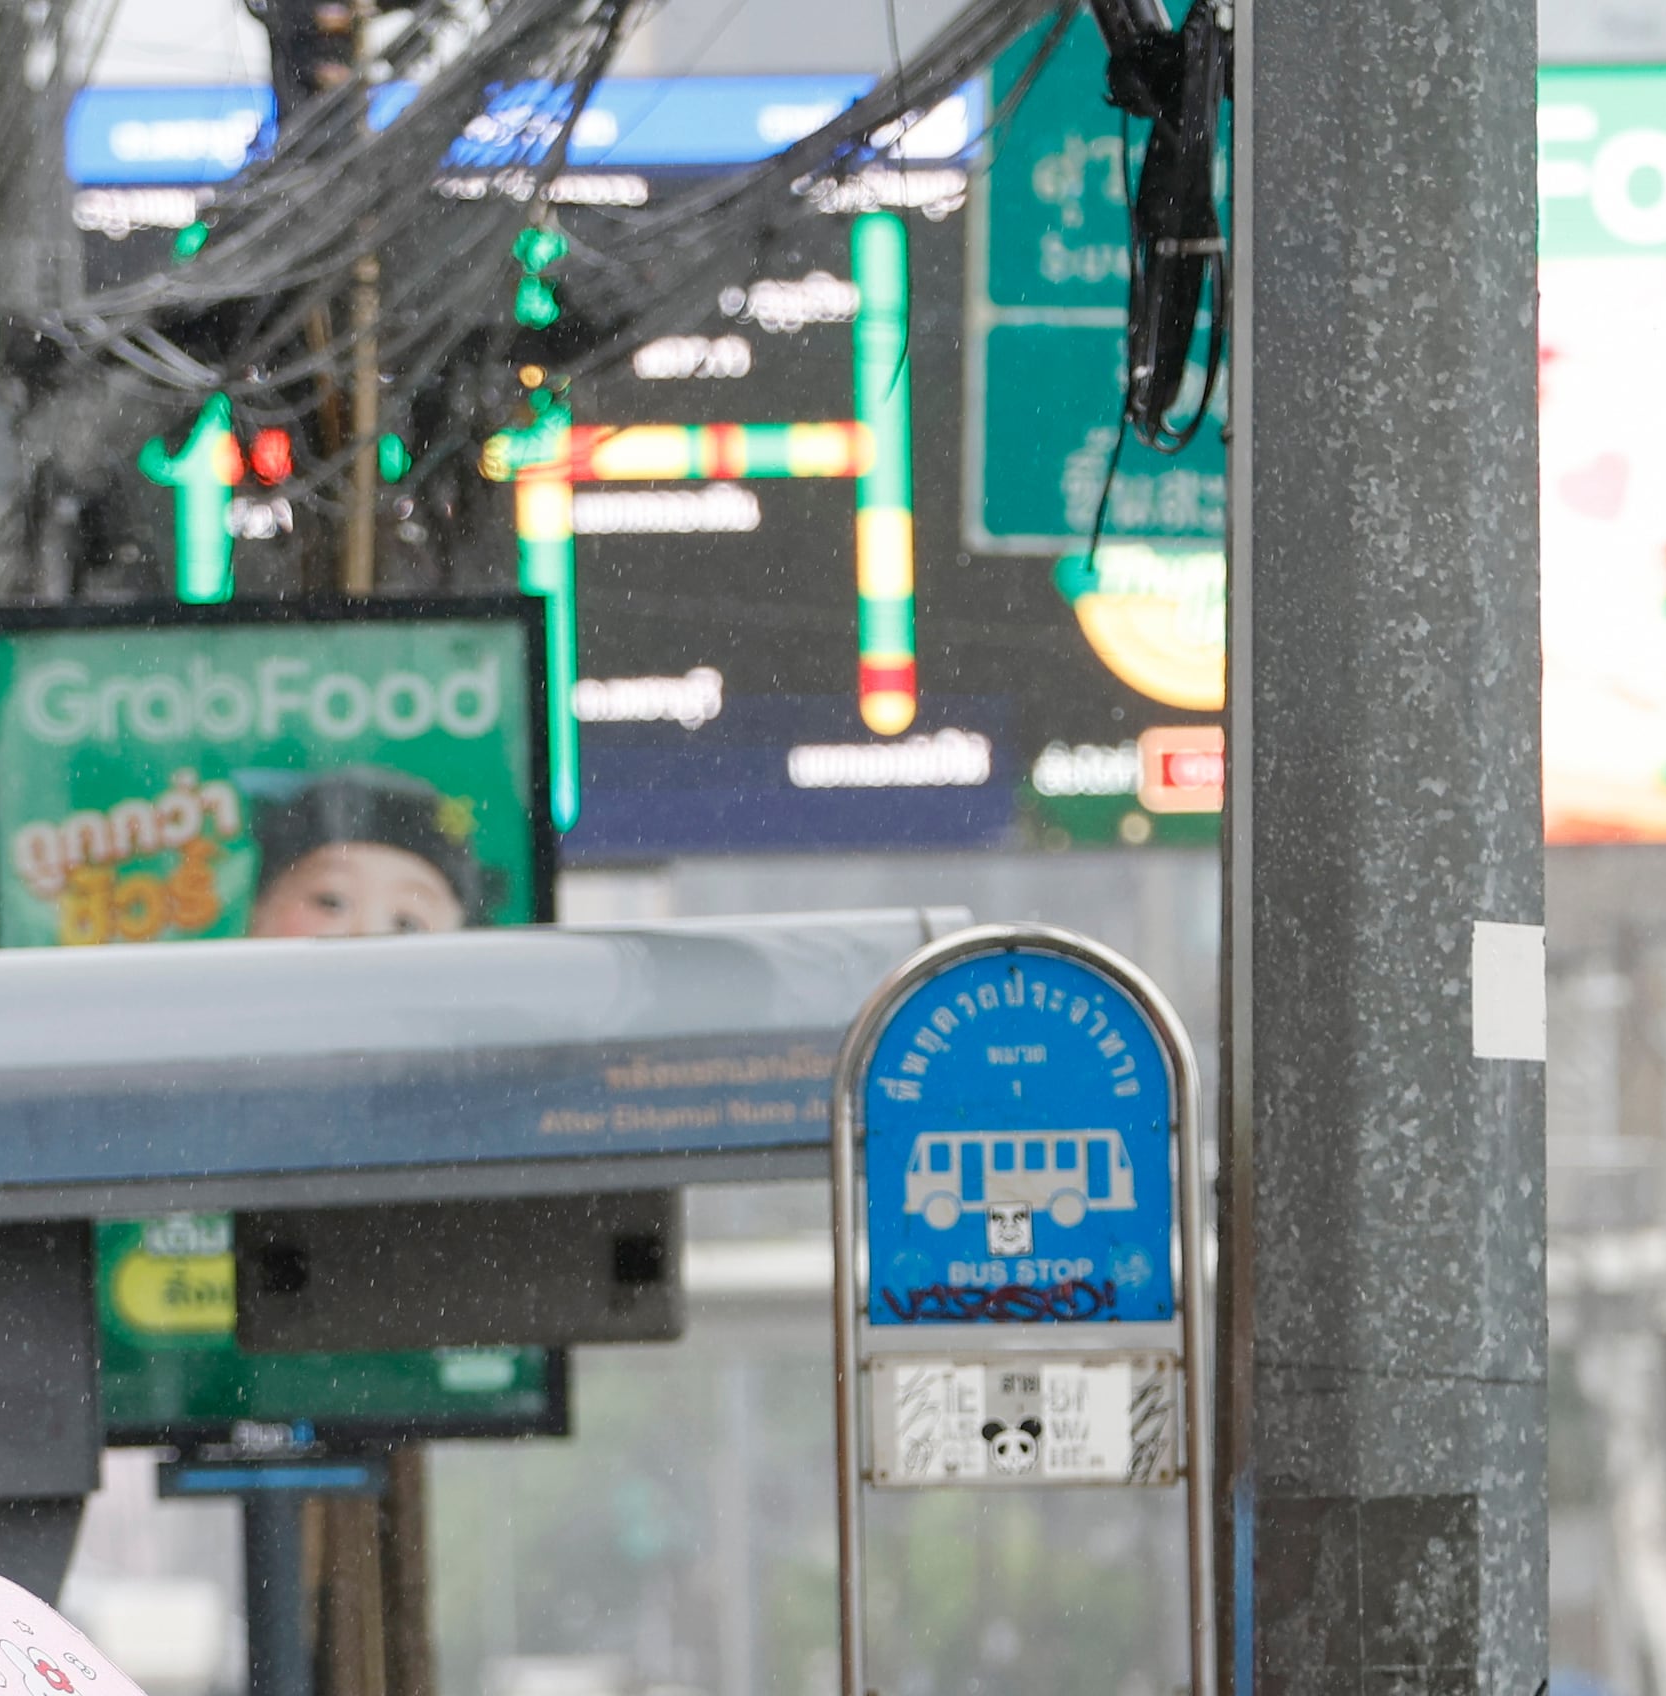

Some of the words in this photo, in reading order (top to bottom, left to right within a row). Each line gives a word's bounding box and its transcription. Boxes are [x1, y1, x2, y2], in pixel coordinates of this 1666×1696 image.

[23, 654, 499, 744] GrabFood
[877, 966, 1141, 1101] ที่หยุดรถประจำทาง
[948, 1259, 1008, 1287] BUS
[1015, 1257, 1094, 1286] STOP
